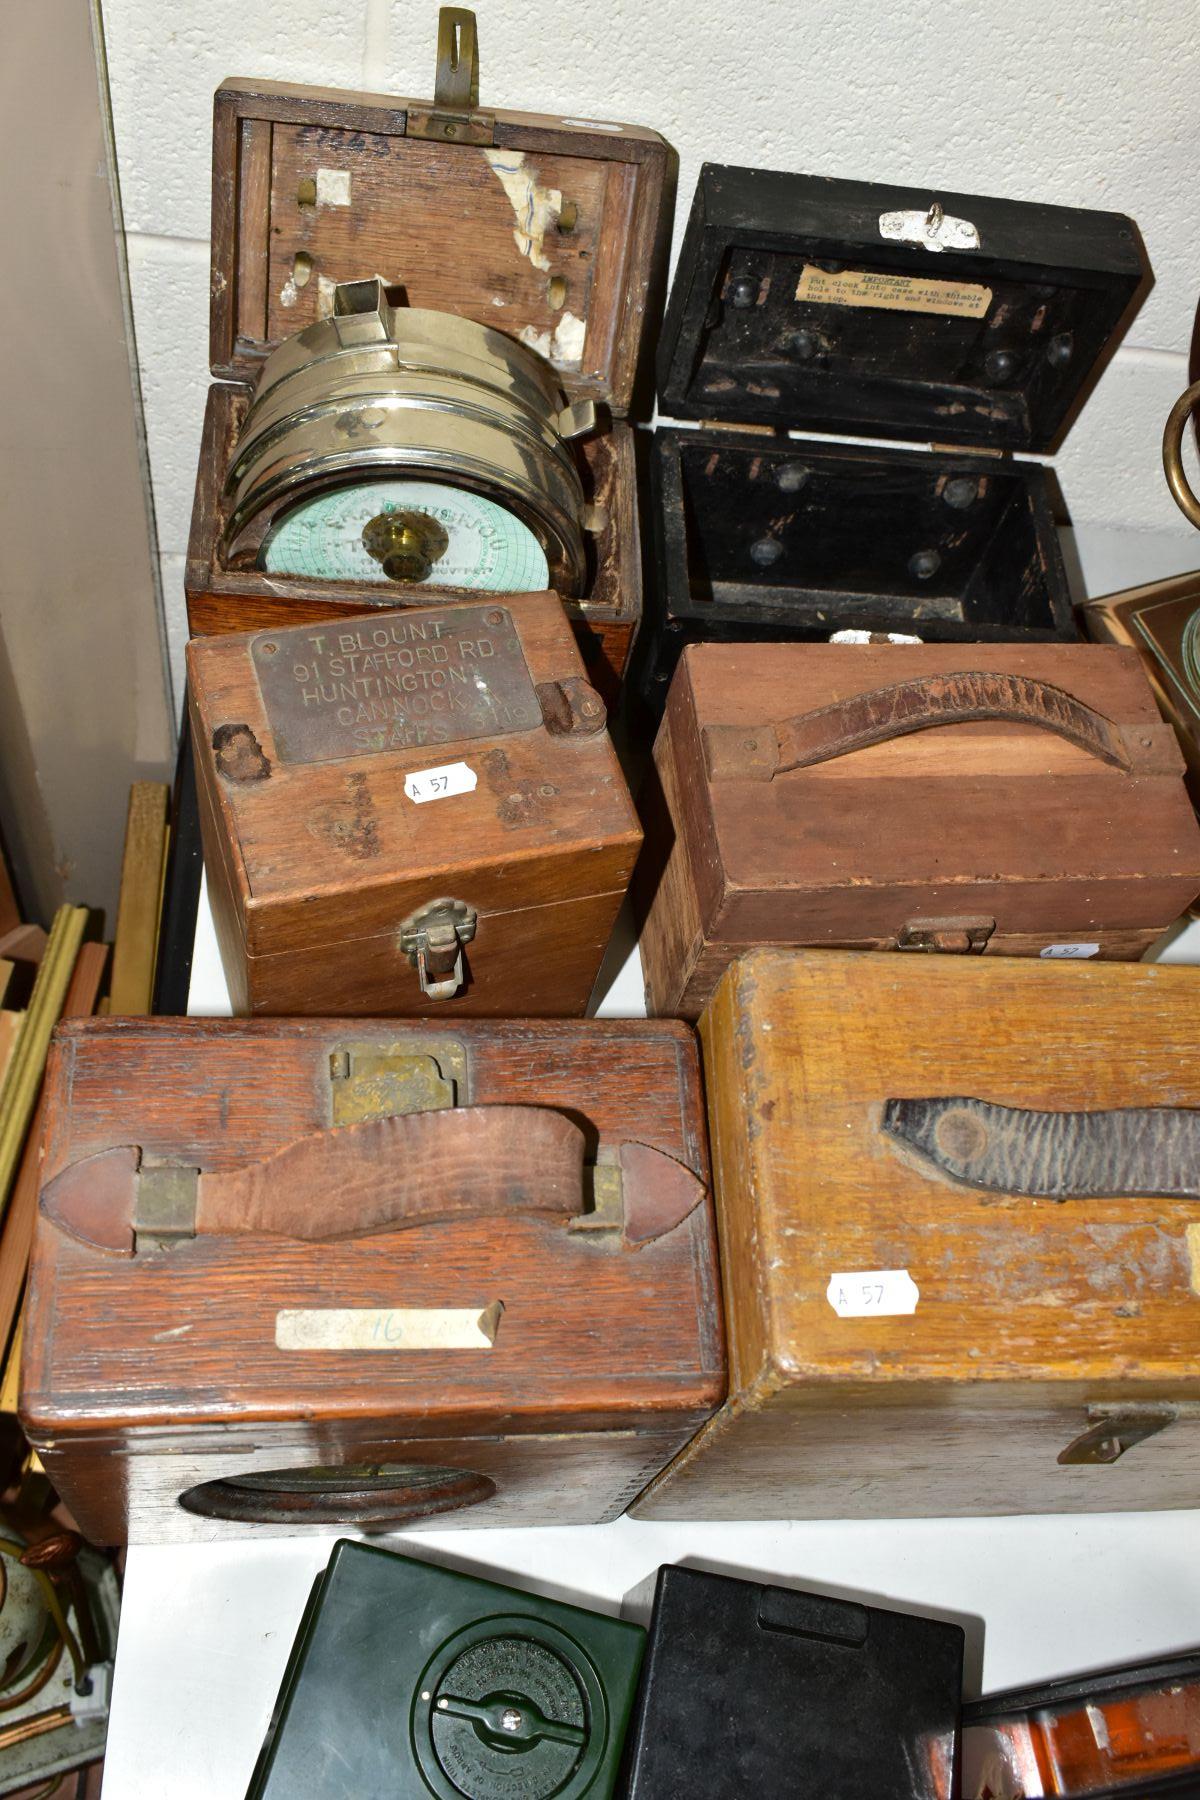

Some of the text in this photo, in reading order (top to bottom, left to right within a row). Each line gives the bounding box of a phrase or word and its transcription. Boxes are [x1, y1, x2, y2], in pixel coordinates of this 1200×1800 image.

[810, 277, 826, 286] Put
[832, 280, 859, 289] clock
[865, 283, 886, 291] into
[945, 291, 983, 301] thimble
[861, 275, 912, 287] IMPORTANT
[808, 284, 829, 293] hole
[851, 289, 868, 297] the
[873, 291, 900, 301] right
[968, 301, 980, 309] at
[293, 639, 494, 683] 91 STAFFORD RD
[302, 666, 468, 707] HUNTINGTON
[337, 690, 469, 726] CANNOCK
[352, 722, 448, 749] STAFFS
[412, 776, 448, 796] A 57
[1061, 947, 1079, 956] 57
[839, 1285, 884, 1304] A 57
[372, 1312, 402, 1342] 16
